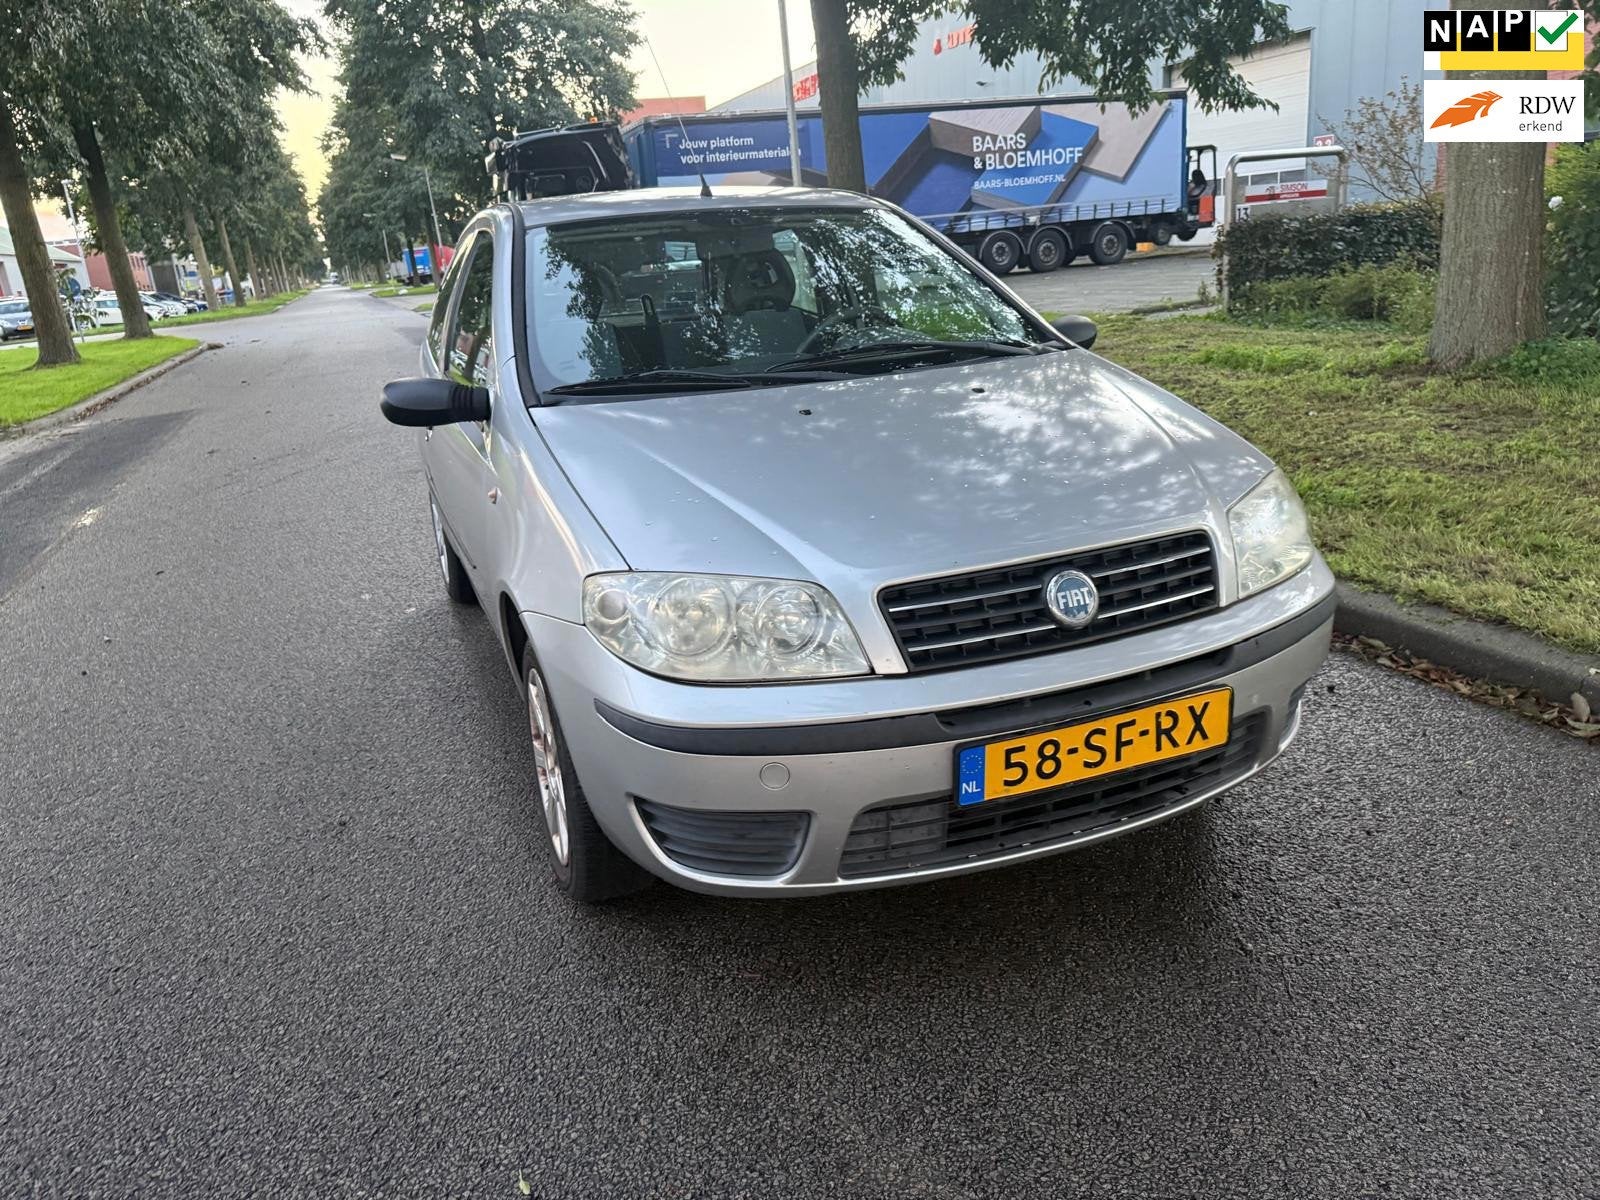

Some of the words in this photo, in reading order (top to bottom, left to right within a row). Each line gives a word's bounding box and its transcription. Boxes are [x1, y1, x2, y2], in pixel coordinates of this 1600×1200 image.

[679, 137, 707, 150] Jouw
[710, 135, 754, 150] platform
[972, 132, 1027, 153] BAARS
[680, 154, 704, 165] voor
[706, 147, 801, 163] interieurmaterial
[973, 156, 983, 170] &
[985, 147, 1083, 171] BLOEMHOFF
[974, 174, 1066, 190] BAARS-BLOEMHOFF.NL
[1280, 182, 1308, 193] SIMSON
[1237, 207, 1249, 221] 13
[1057, 587, 1090, 610] FIAT
[1003, 701, 1211, 787] 58-SF-RX
[962, 780, 981, 794] NL
